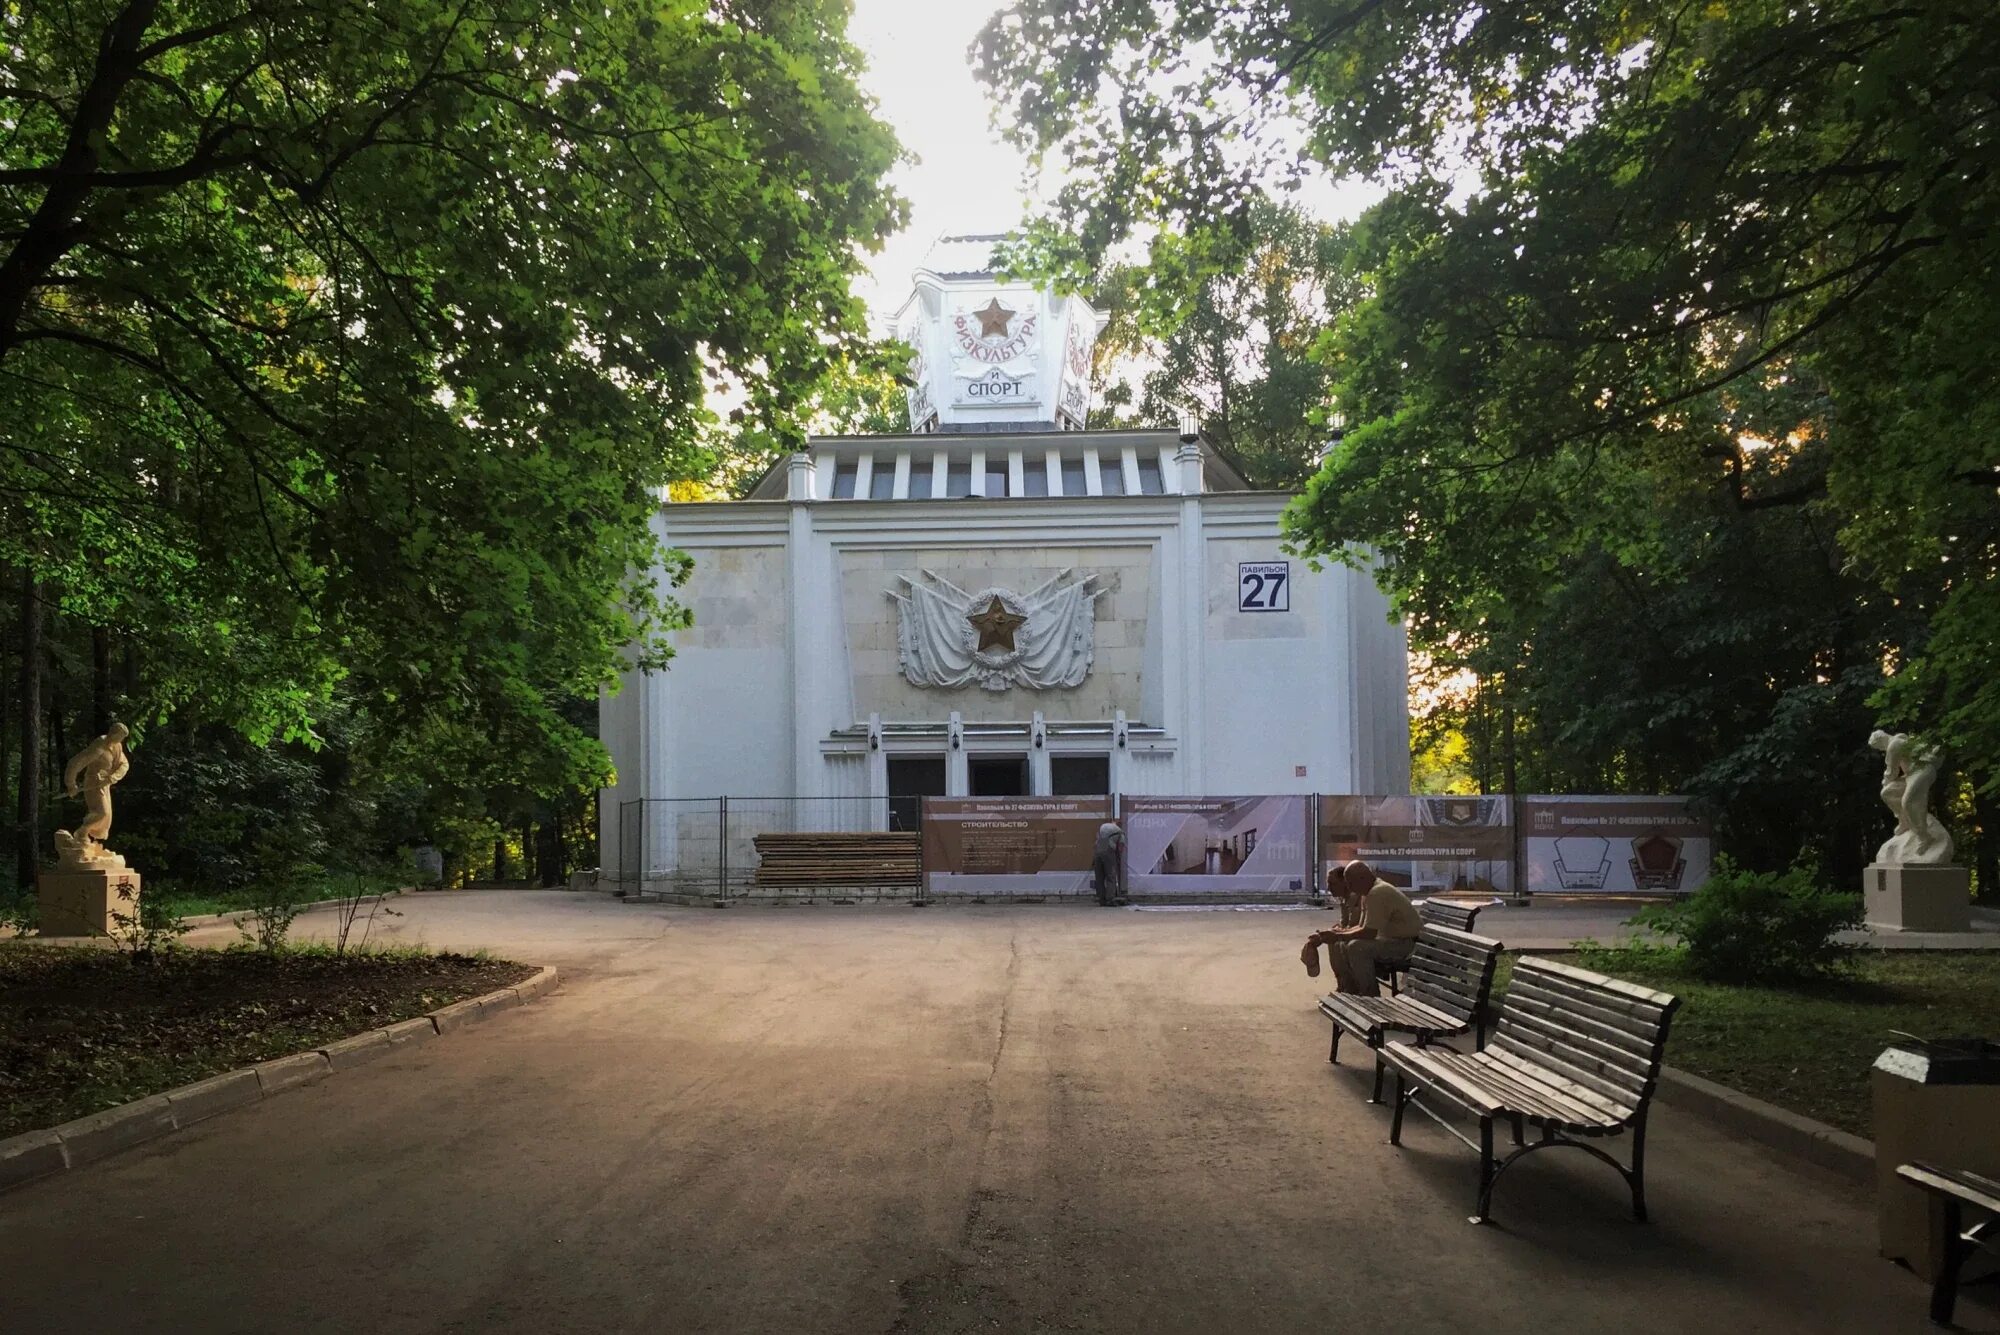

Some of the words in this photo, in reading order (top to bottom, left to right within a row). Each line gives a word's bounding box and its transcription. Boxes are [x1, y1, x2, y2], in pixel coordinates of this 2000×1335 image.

[954, 315, 1037, 362] ФИЗКУЛЬТУРА
[991, 371, 999, 379] И
[968, 381, 1022, 396] СПОРТ
[1242, 573, 1286, 607] 27
